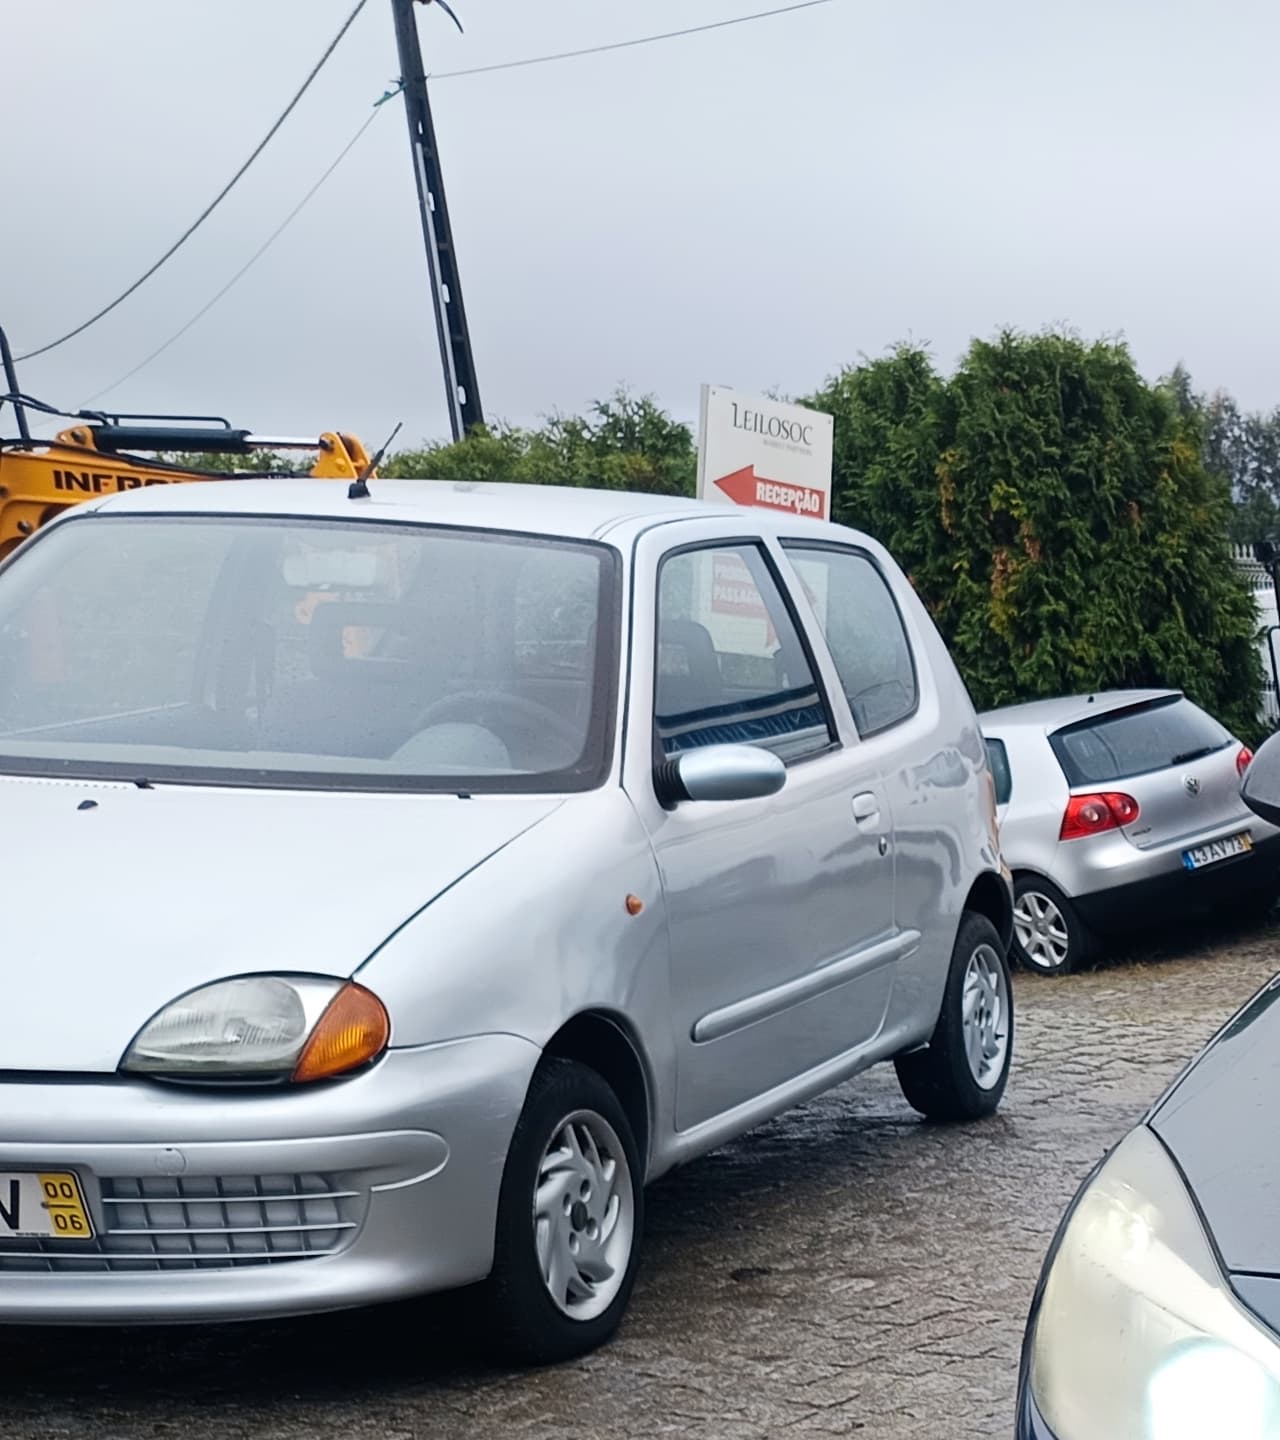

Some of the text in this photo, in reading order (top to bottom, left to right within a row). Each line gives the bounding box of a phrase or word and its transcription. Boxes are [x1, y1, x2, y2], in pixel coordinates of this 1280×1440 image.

[731, 402, 814, 446] LEILOSOC
[53, 470, 182, 493] INFR
[756, 481, 821, 514] RECEPÇÃO
[44, 1182, 74, 1199] 00
[54, 1214, 83, 1231] 06
